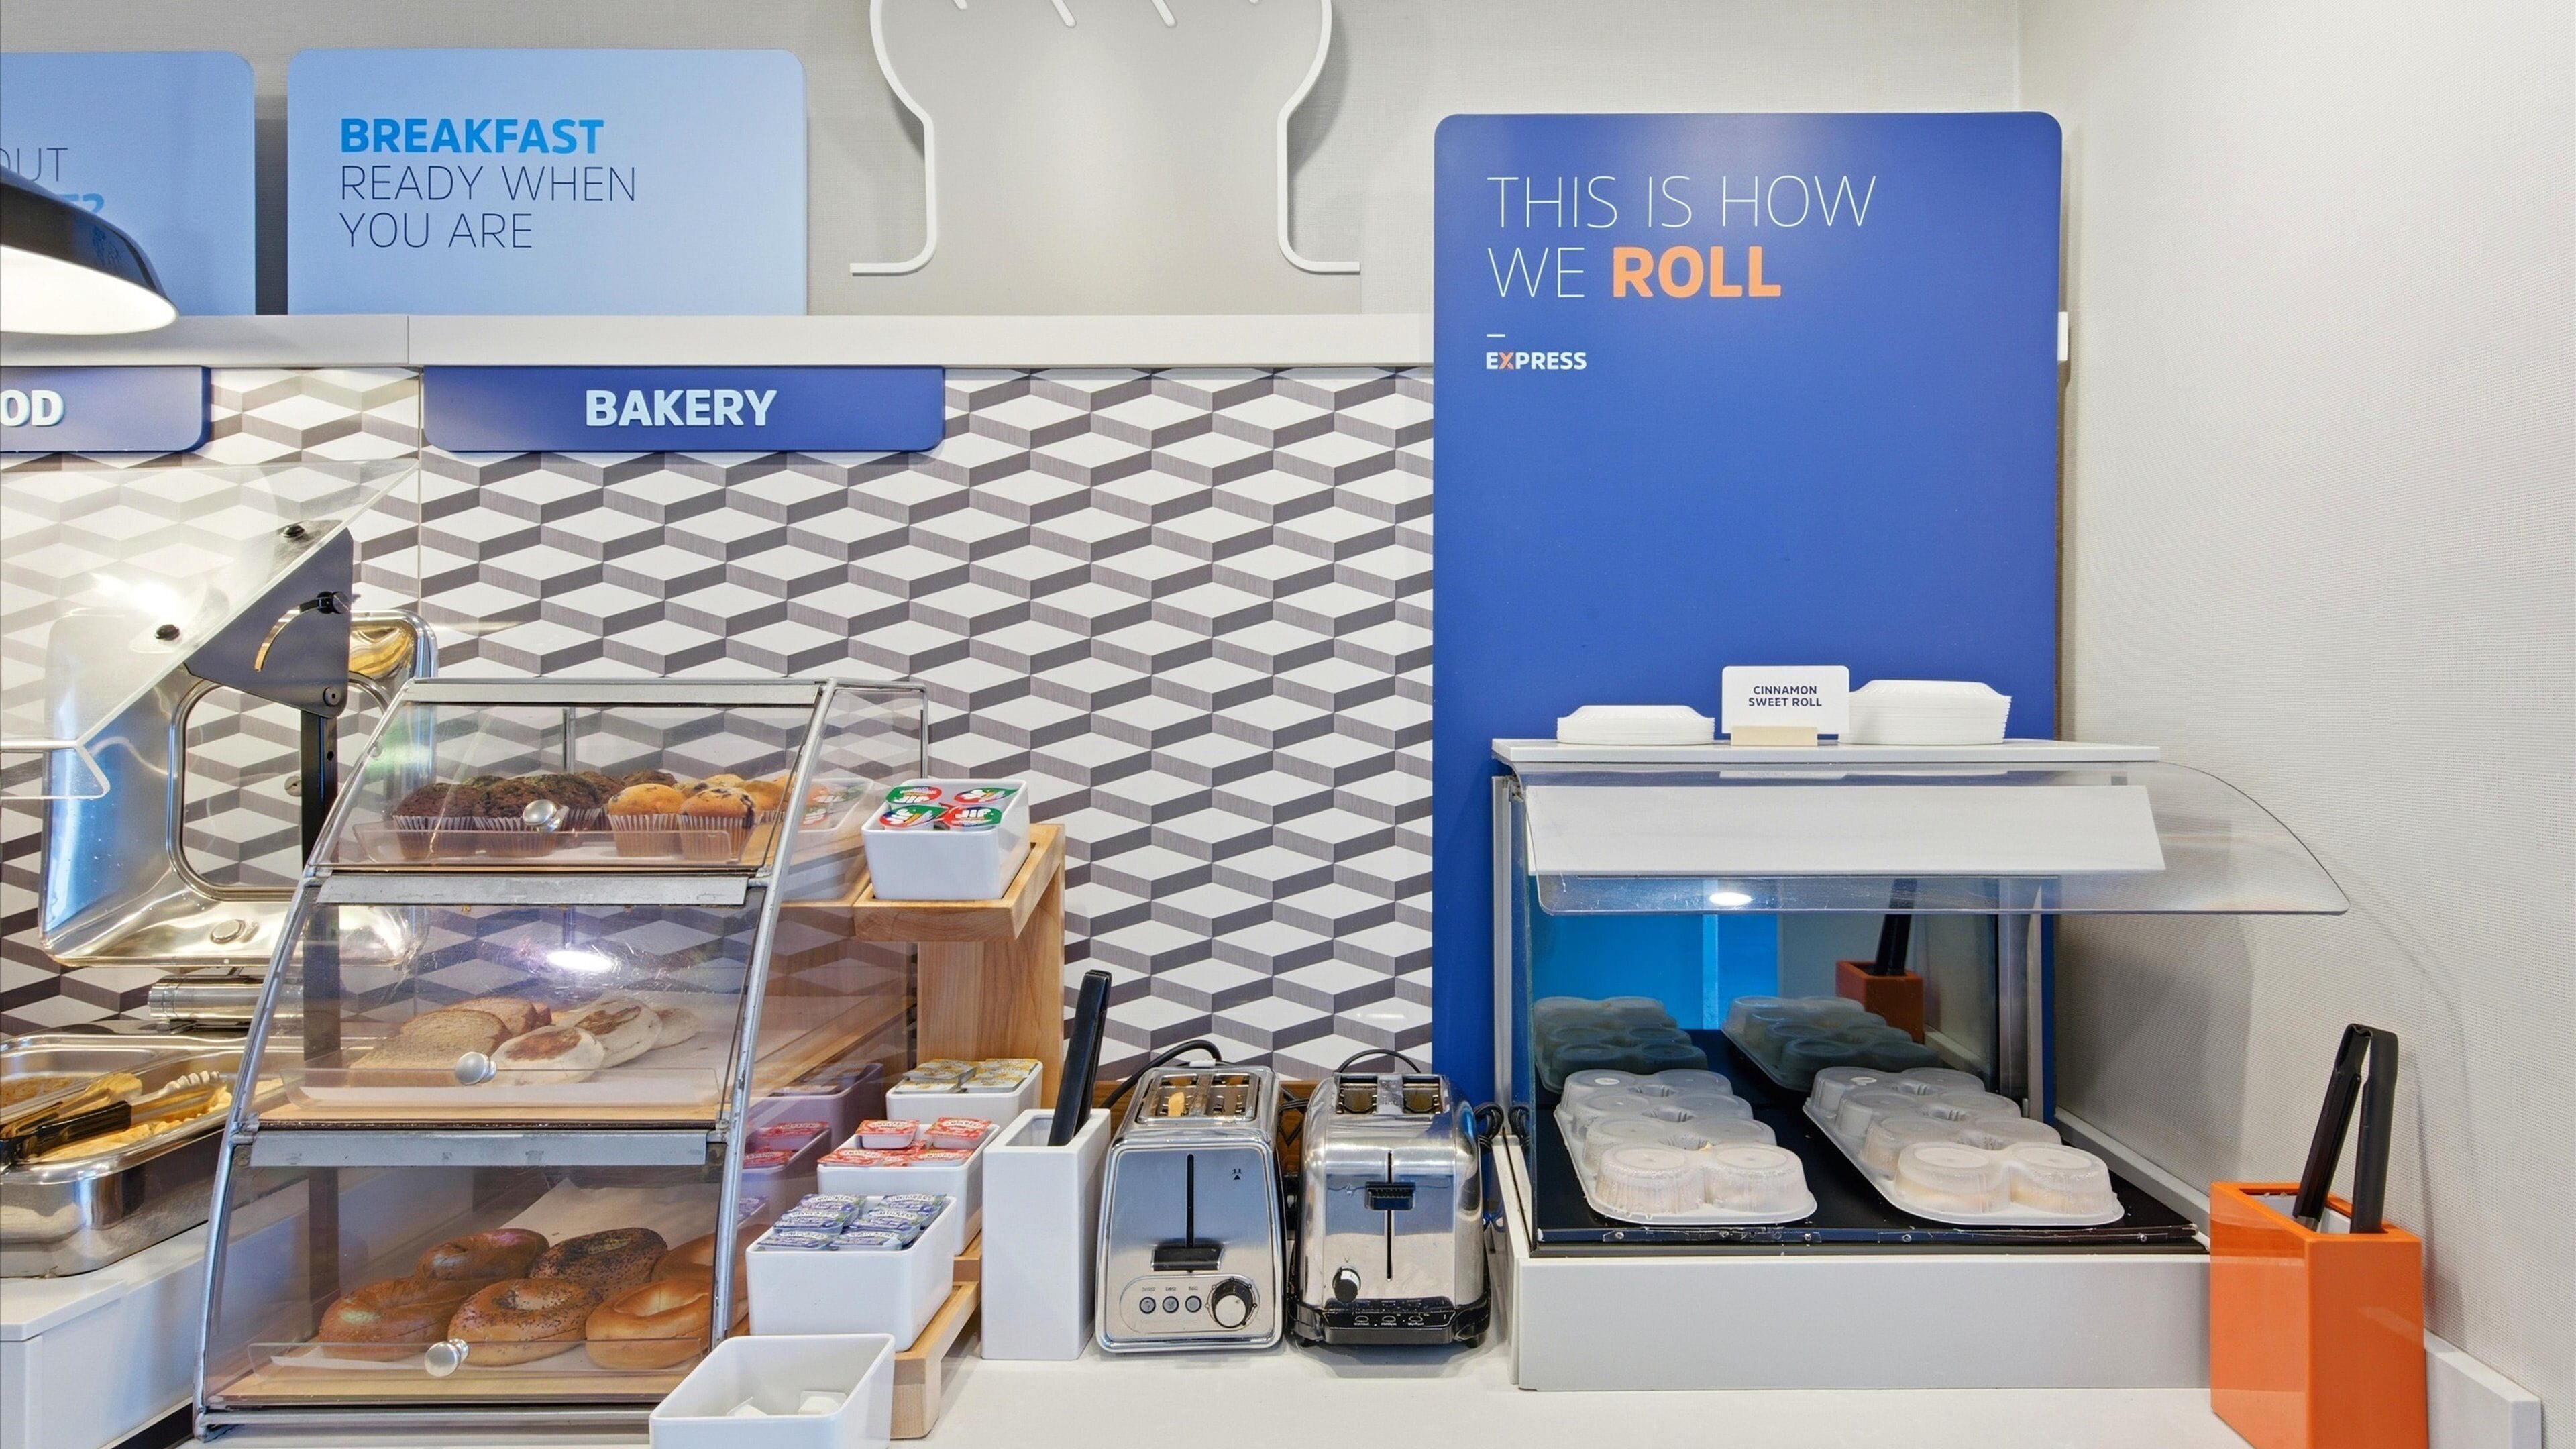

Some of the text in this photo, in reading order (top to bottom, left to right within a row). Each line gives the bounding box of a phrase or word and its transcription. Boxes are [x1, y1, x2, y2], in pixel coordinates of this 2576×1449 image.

[341, 118, 604, 154] BREAKFAST
[342, 165, 635, 201] READY WHEN
[1487, 174, 1876, 228] THIS IS HOW
[339, 211, 532, 248] YOU ARE
[1487, 245, 1781, 299] WE ROLL
[1486, 351, 1587, 370] EXPRESS
[586, 389, 777, 427] BAKERY
[1748, 697, 1823, 707] SWEET ROLL
[1753, 685, 1817, 695] CINNAMON
